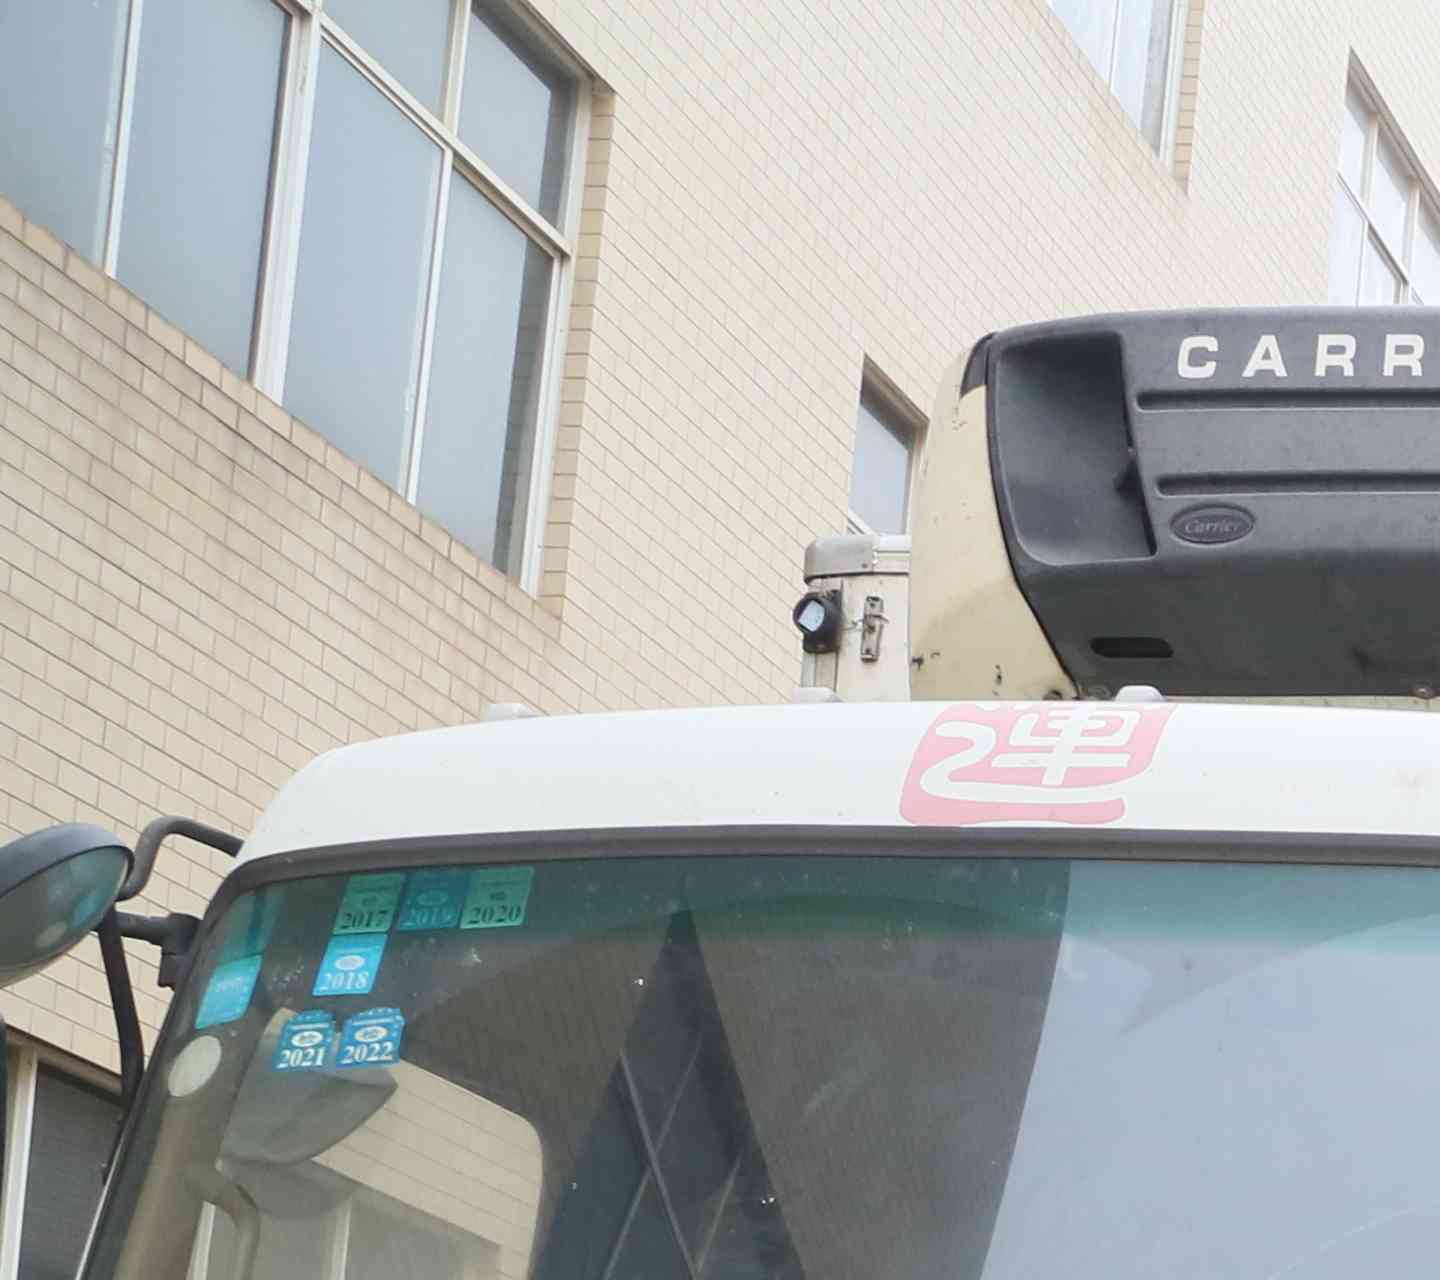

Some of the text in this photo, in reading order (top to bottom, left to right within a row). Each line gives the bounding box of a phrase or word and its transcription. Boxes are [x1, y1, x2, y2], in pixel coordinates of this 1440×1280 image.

[340, 910, 388, 930] 2017
[468, 903, 520, 925] 2020
[319, 969, 369, 992] 2018
[276, 1048, 326, 1070] 2021
[344, 1041, 394, 1066] 2022
